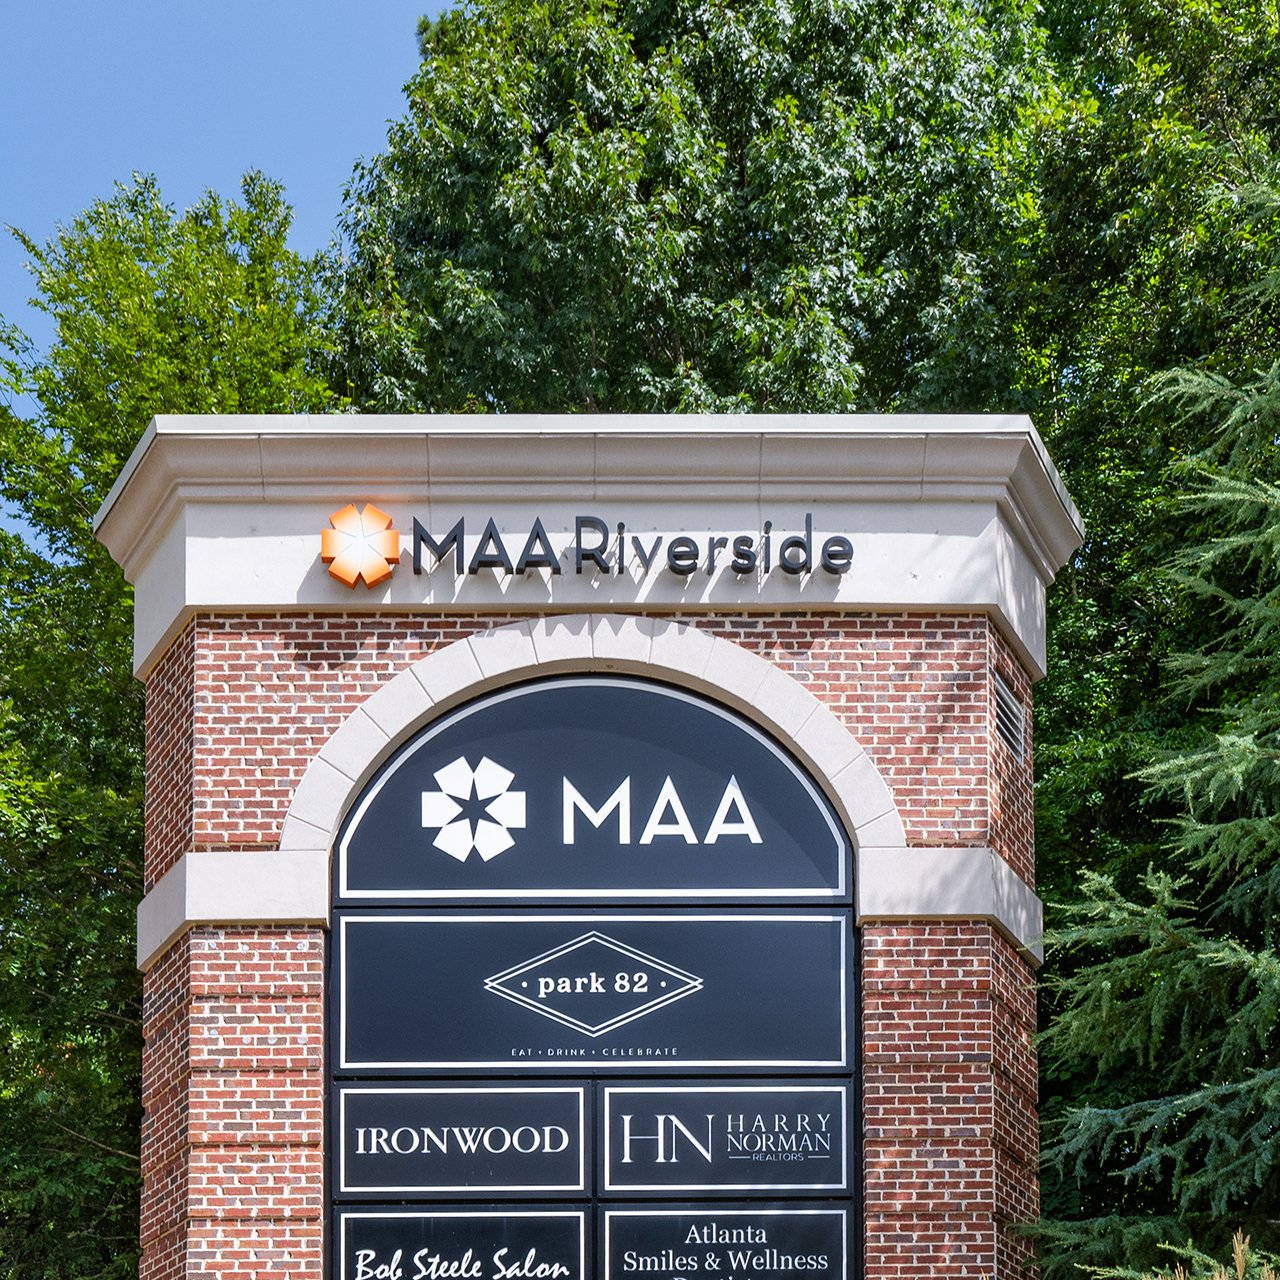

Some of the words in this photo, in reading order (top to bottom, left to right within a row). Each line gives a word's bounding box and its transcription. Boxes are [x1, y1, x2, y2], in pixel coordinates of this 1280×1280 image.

[412, 515, 561, 575] MAA
[575, 512, 855, 576] Riverside
[562, 774, 764, 845] MAA
[537, 971, 607, 999] park
[614, 972, 649, 994] 82
[511, 1048, 532, 1057] EAT
[547, 1048, 587, 1057] DRINK
[602, 1047, 678, 1056] CELEBRATE
[727, 1113, 831, 1132] HARRY
[355, 1125, 569, 1155] IRONWOOD
[620, 1114, 714, 1164] HN
[727, 1133, 831, 1152] NORMAN
[752, 1153, 804, 1162] REALTORS
[684, 1222, 768, 1245] Atlanta
[412, 1247, 483, 1280] Steele
[493, 1247, 570, 1280] Salon
[623, 1249, 698, 1272] Smiles
[704, 1251, 721, 1271] &
[727, 1248, 829, 1271] Wellness
